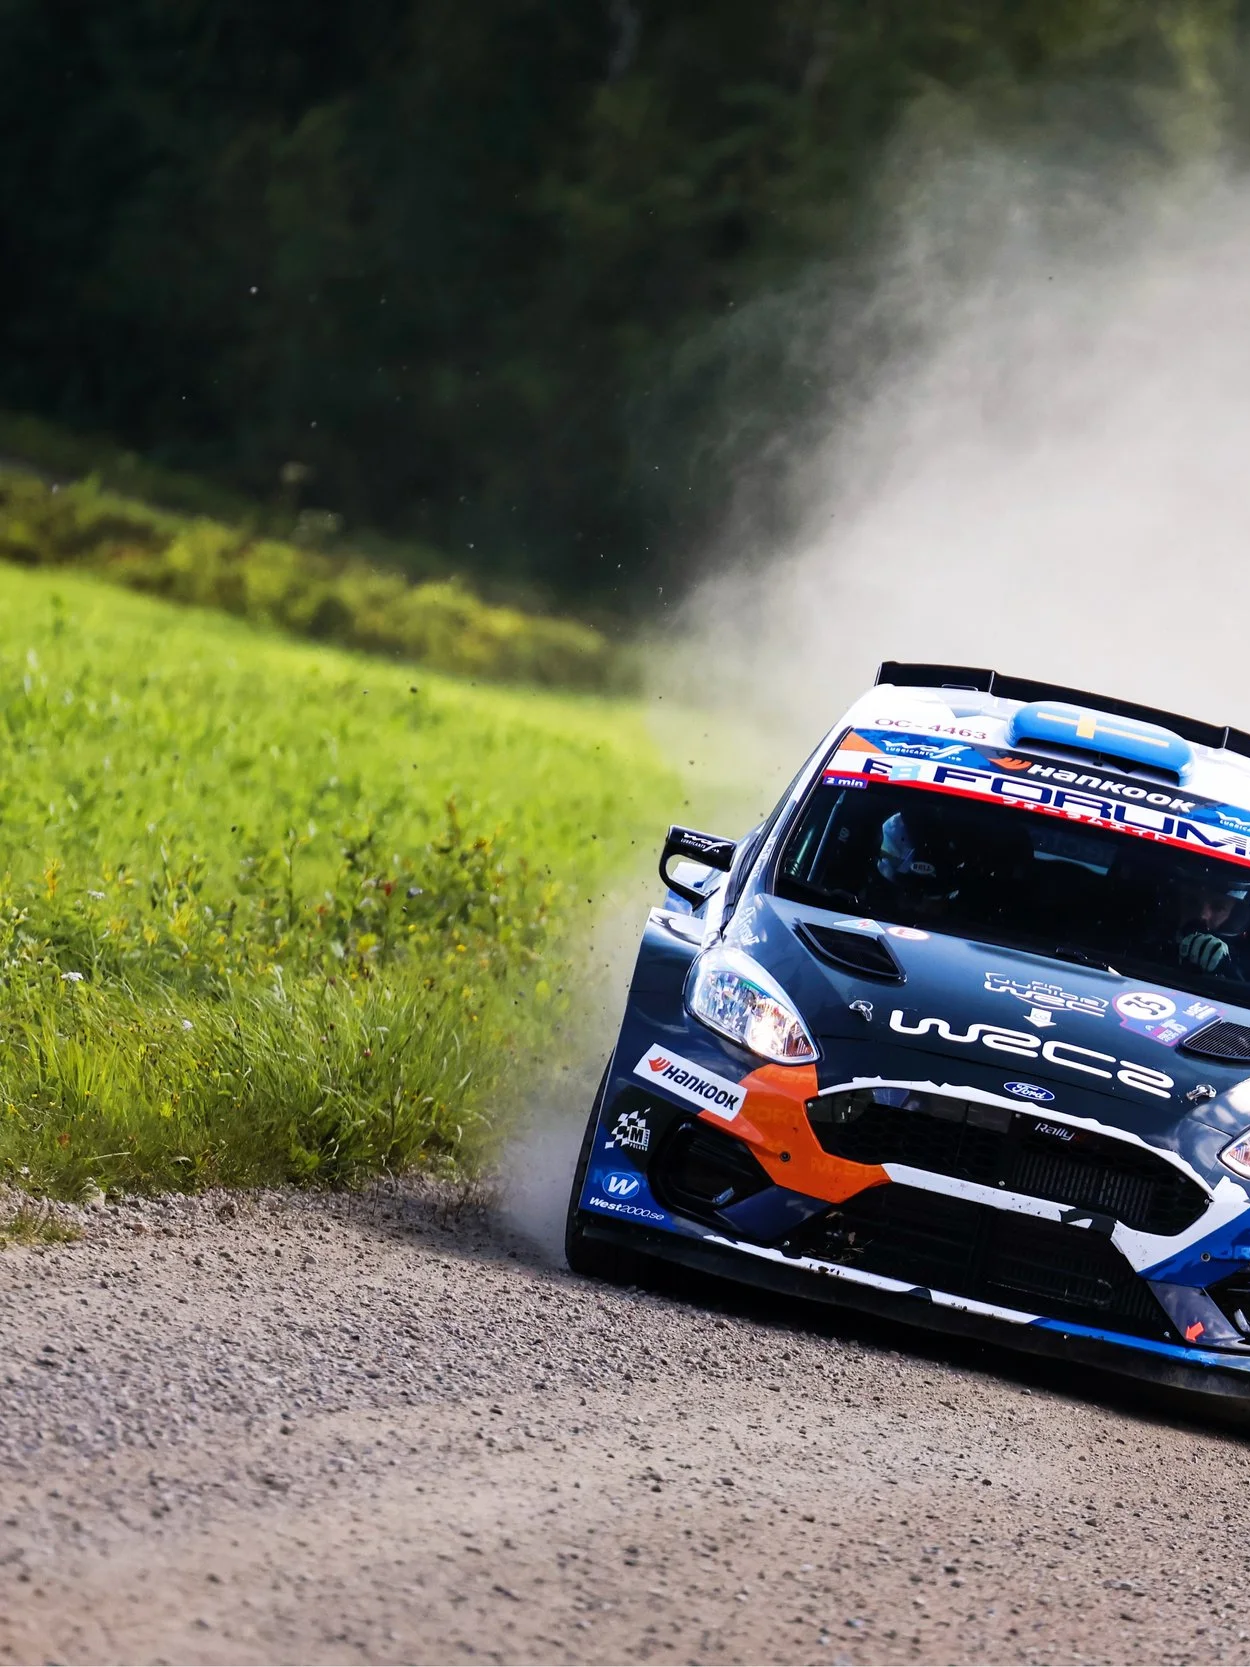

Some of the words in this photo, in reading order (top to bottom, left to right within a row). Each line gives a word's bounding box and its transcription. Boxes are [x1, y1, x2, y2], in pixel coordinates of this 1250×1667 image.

[875, 718, 987, 740] OC-4463
[826, 776, 835, 785] 2
[838, 778, 864, 788] min
[1002, 797, 1169, 842] フォーラムエイト
[1123, 996, 1168, 1016] 35
[889, 1009, 1175, 1099] WRC2
[1012, 1083, 1047, 1099] Ford
[1034, 1122, 1076, 1142] Rally
[588, 1196, 665, 1221] West2000.se
